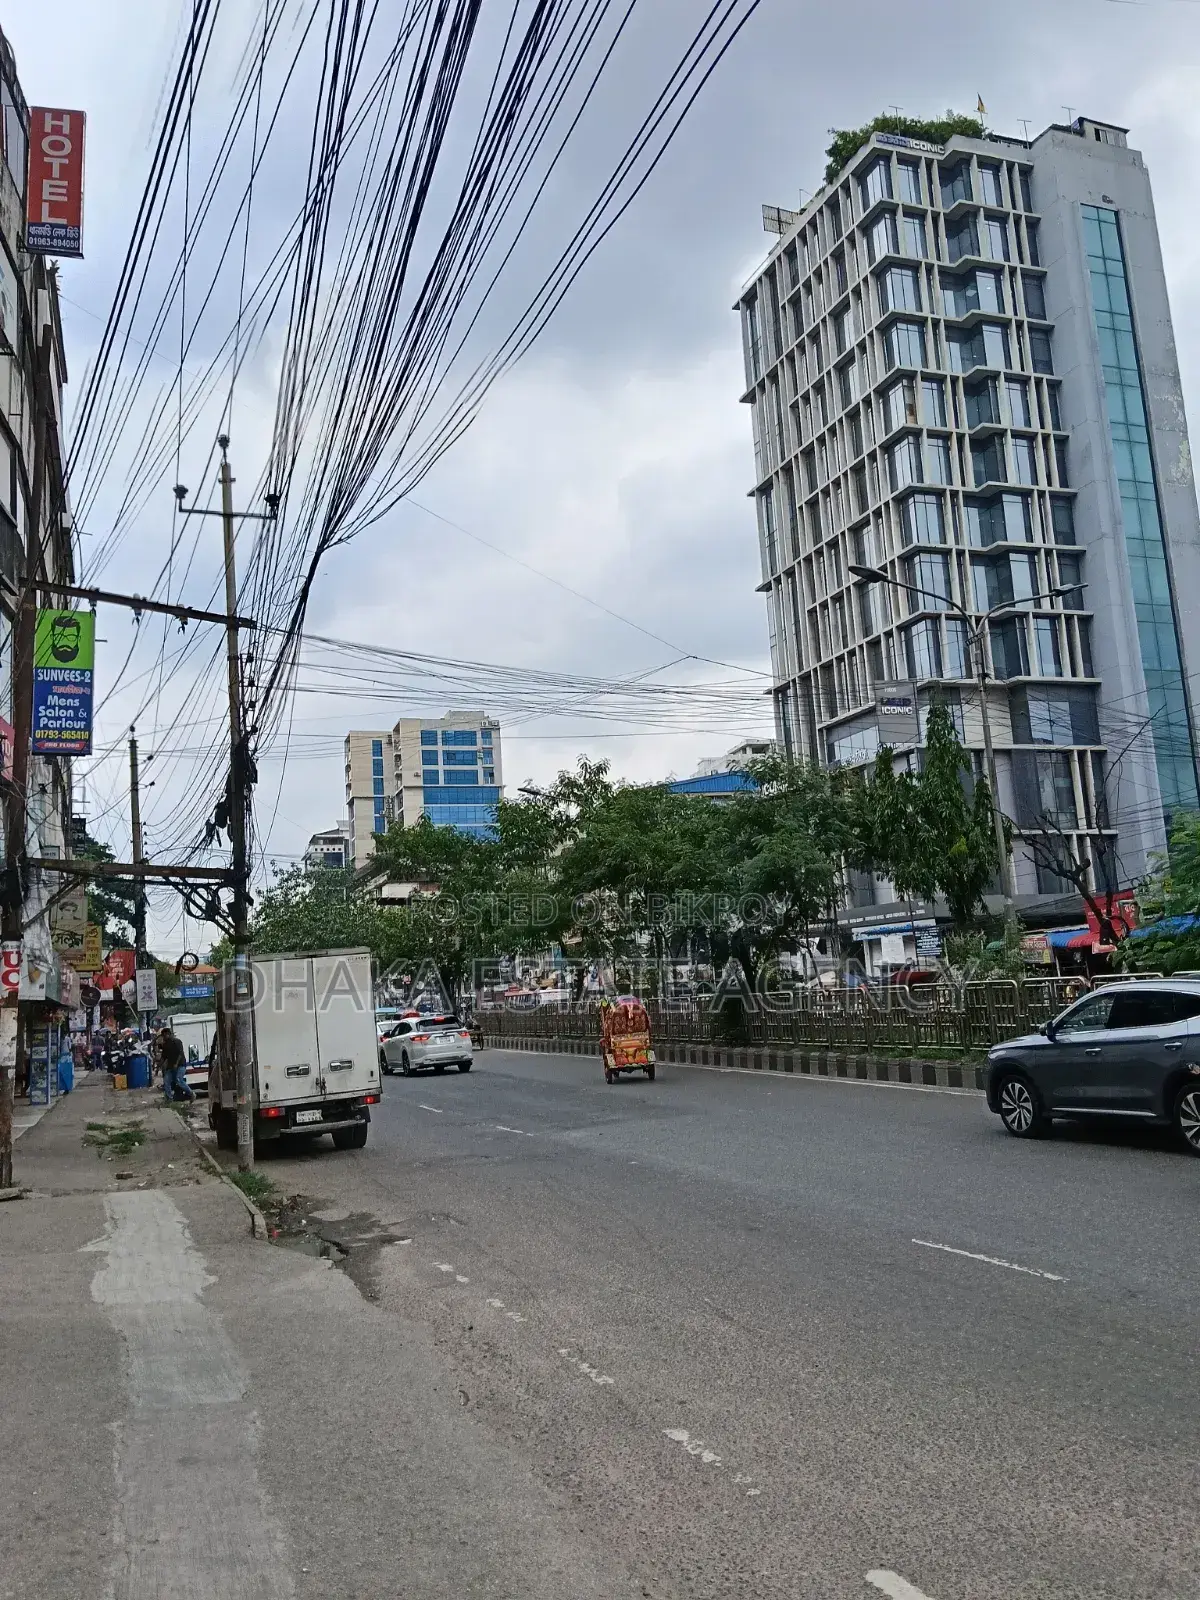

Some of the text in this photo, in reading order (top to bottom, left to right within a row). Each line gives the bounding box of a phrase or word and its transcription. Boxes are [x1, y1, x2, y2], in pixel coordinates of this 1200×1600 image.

[909, 139, 946, 154] ICONIC
[41, 112, 73, 225] HOTEL
[52, 227, 66, 238] লেক
[47, 695, 80, 707] Mens
[38, 706, 87, 718] Salon &
[881, 706, 913, 715] ICONIC
[39, 717, 86, 729] Parlour
